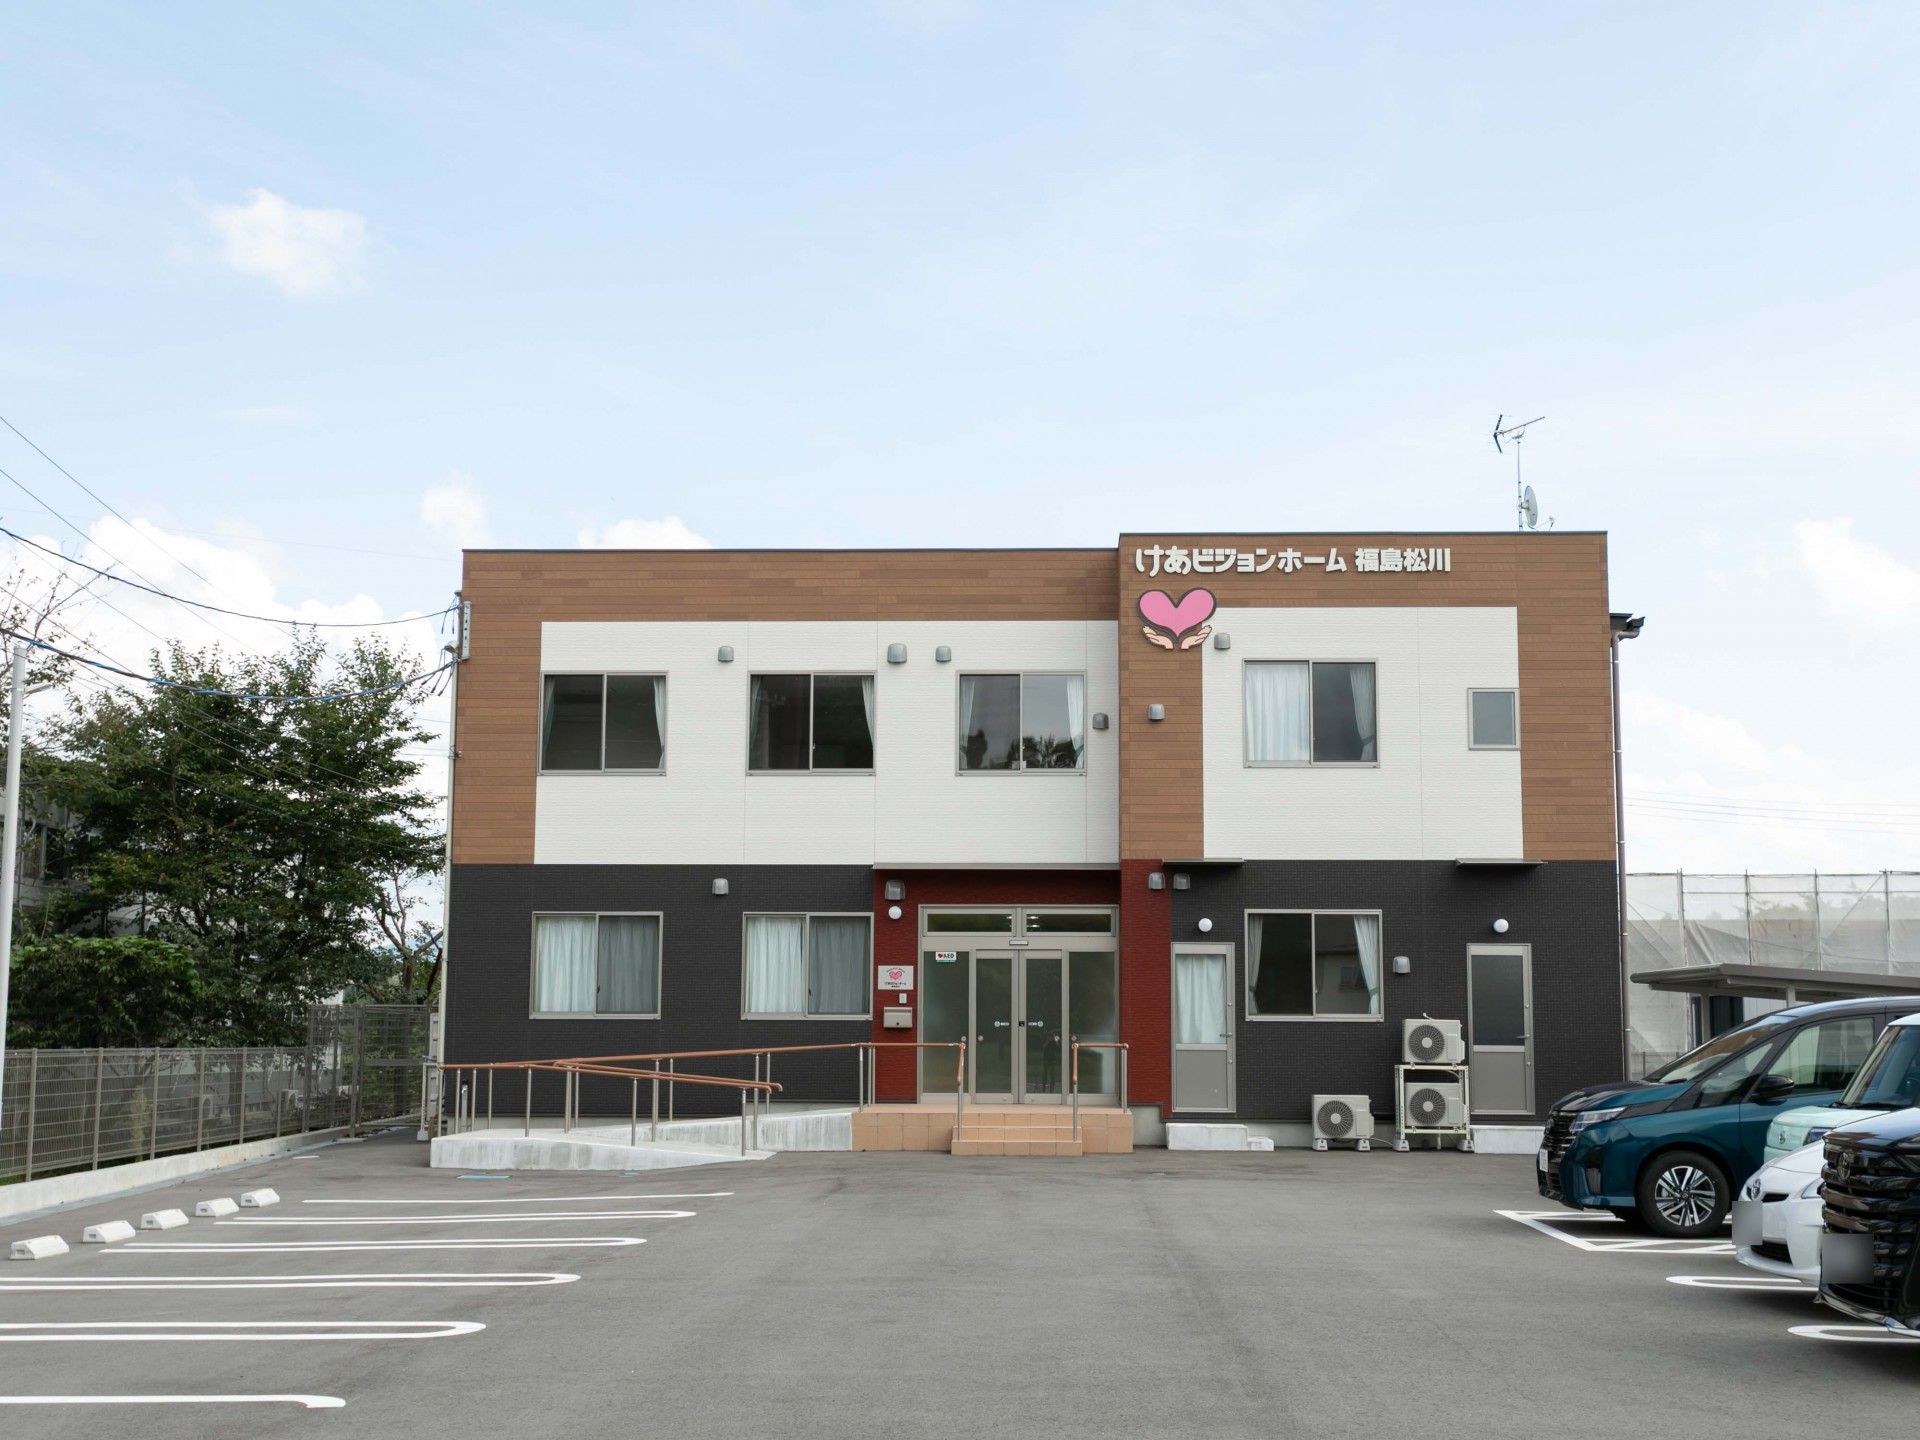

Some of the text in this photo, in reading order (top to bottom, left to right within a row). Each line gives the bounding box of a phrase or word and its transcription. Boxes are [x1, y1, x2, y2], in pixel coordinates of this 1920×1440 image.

[1136, 544, 1451, 577] けあビジョンホーム 福島松川
